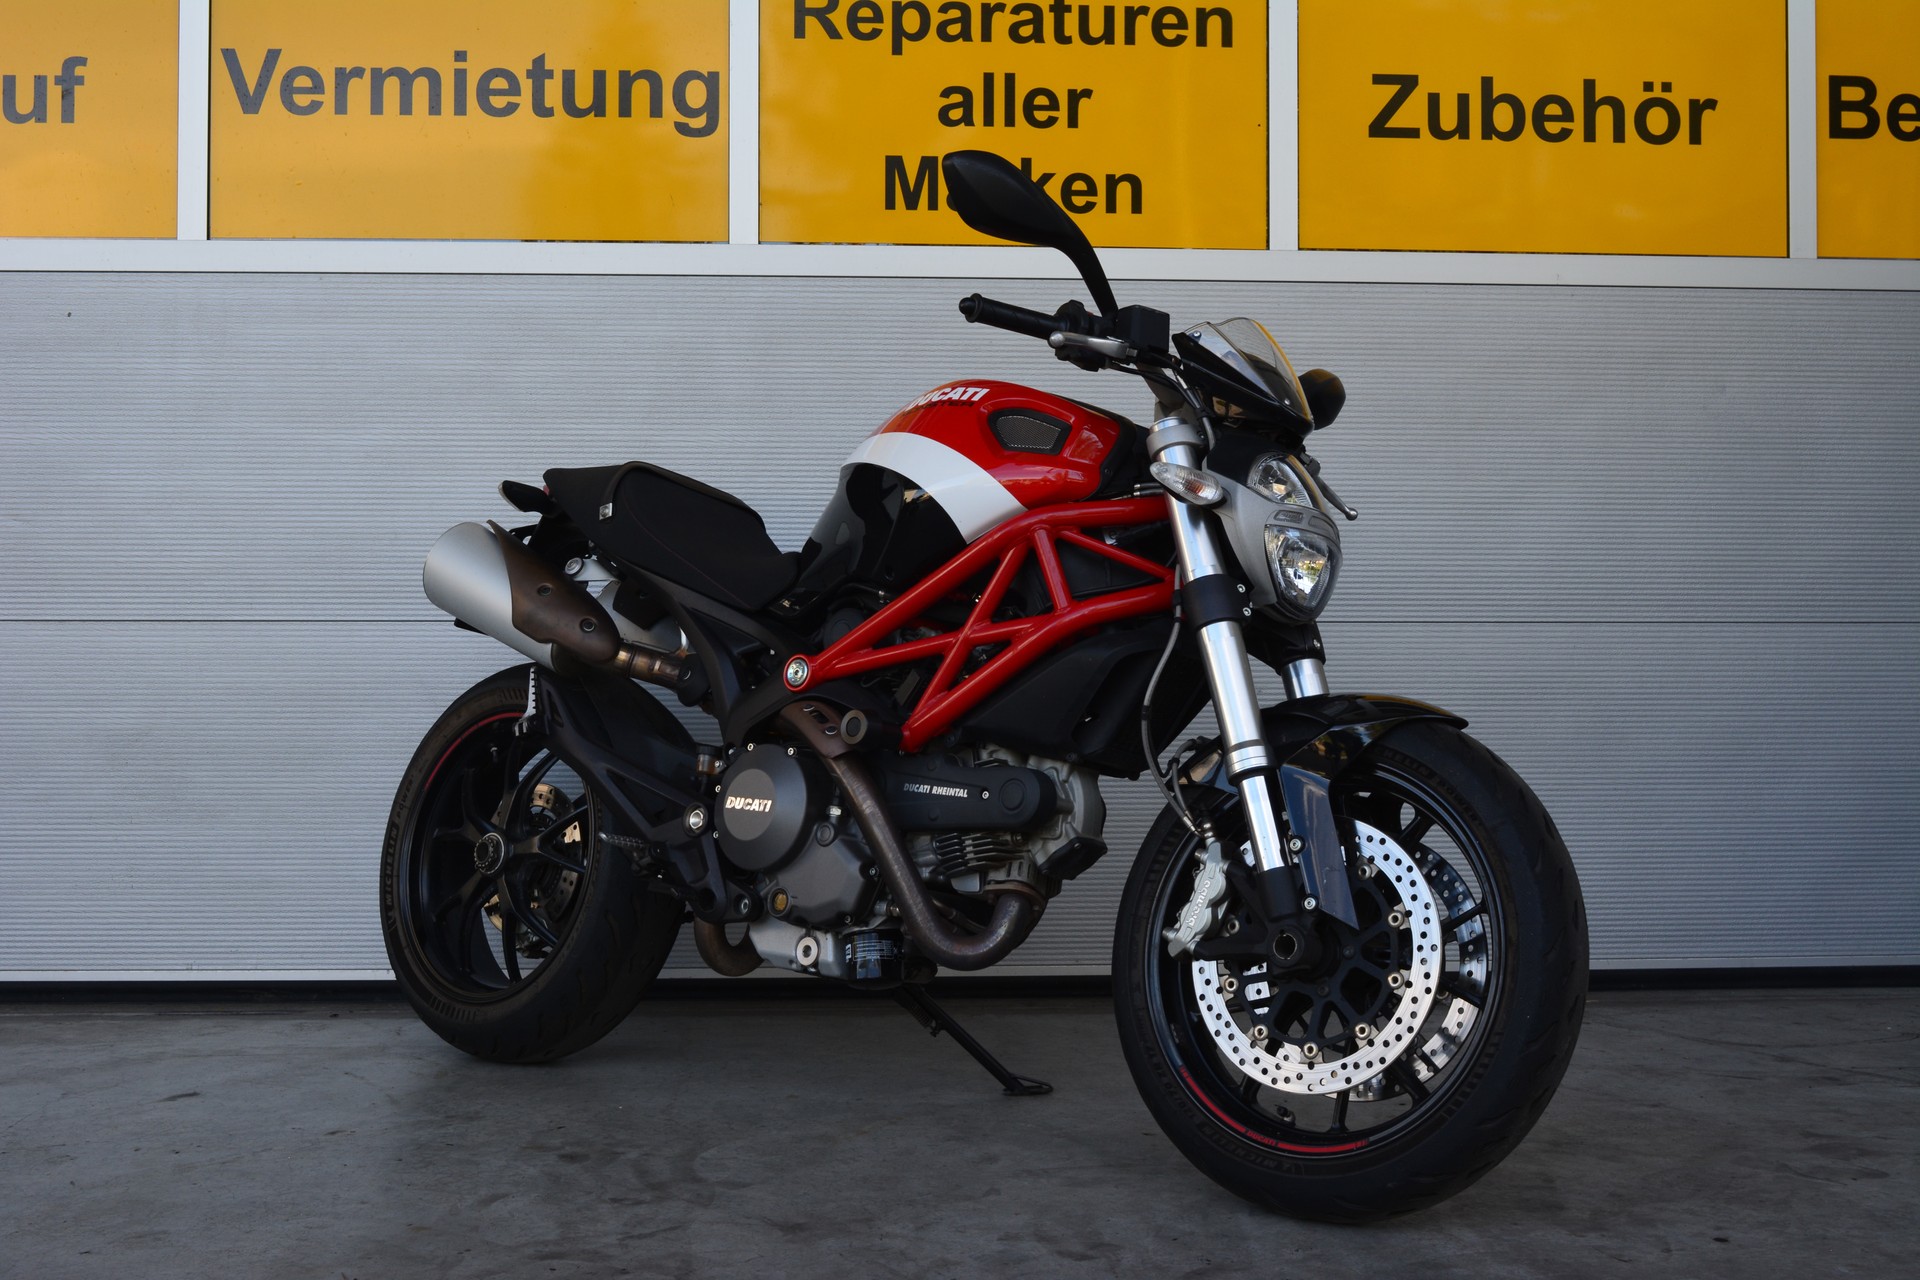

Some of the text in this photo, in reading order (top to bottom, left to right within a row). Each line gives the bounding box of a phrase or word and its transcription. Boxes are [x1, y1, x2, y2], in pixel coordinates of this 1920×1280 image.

[793, 0, 1233, 56] Reparaturen
[2, 57, 88, 124] uf
[220, 48, 720, 138] Vermietung
[936, 73, 1094, 130] aller
[1368, 74, 1720, 147] Zubehör
[1828, 74, 1920, 143] Be
[884, 155, 1143, 216] Mken
[904, 386, 990, 411] DUCATI
[725, 796, 773, 813] DUCATI
[903, 783, 968, 798] DUCATI RHEINTAL
[385, 826, 398, 906] MICHELIN
[1185, 880, 1211, 927] brembo
[1201, 1126, 1278, 1168] MICHELIN
